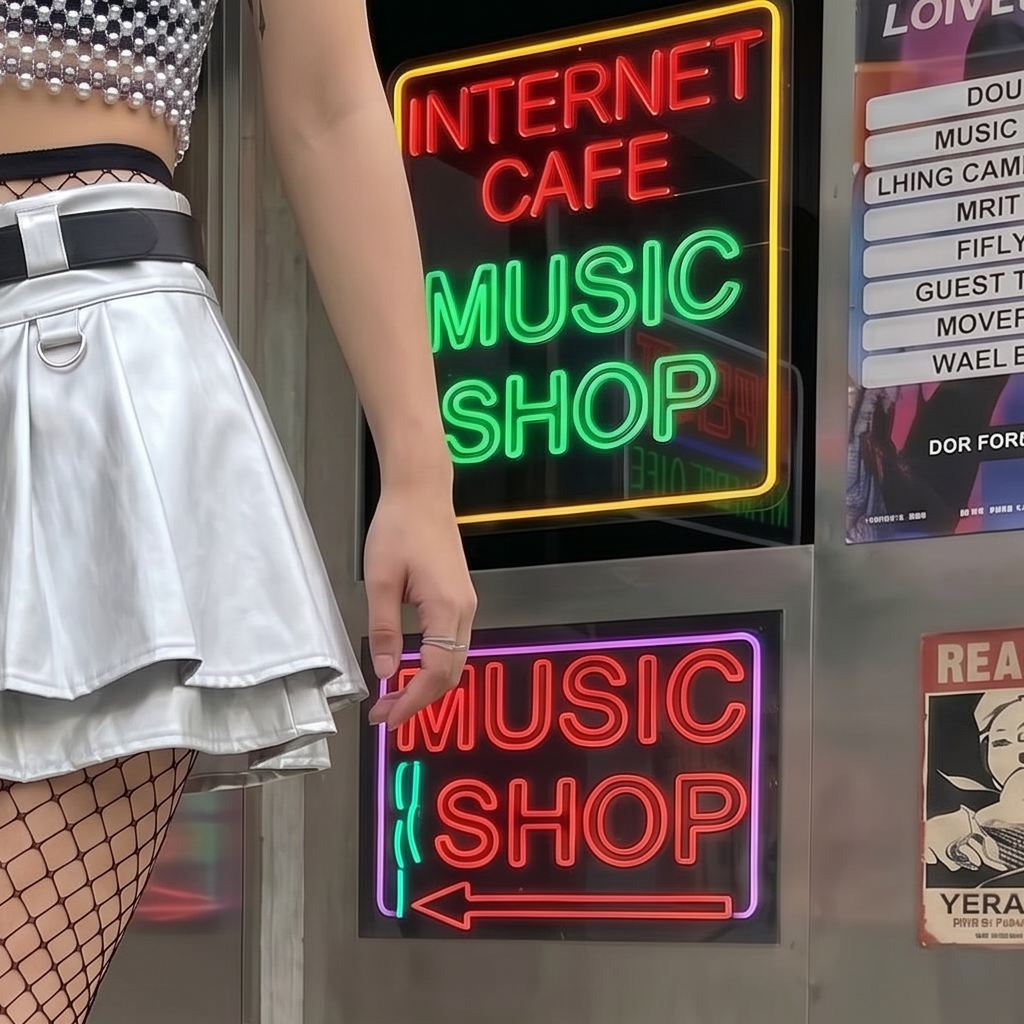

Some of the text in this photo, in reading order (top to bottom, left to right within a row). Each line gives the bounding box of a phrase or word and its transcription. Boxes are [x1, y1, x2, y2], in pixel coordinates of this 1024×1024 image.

[409, 29, 764, 157] INTERNET
[935, 118, 1017, 150] MUSIC
[482, 132, 670, 223] CAFE
[878, 155, 1024, 196] LHING CAM
[957, 194, 1020, 222] MRIT
[426, 229, 740, 353] MUSIC
[916, 272, 1005, 302] GUEST
[933, 349, 1007, 374] WAEL
[442, 353, 717, 464] SHOP
[929, 437, 972, 456] DOR
[937, 641, 1023, 684] REA
[396, 648, 745, 753] MUSIC
[434, 773, 747, 868] SHOP
[940, 893, 1024, 914] YERA
